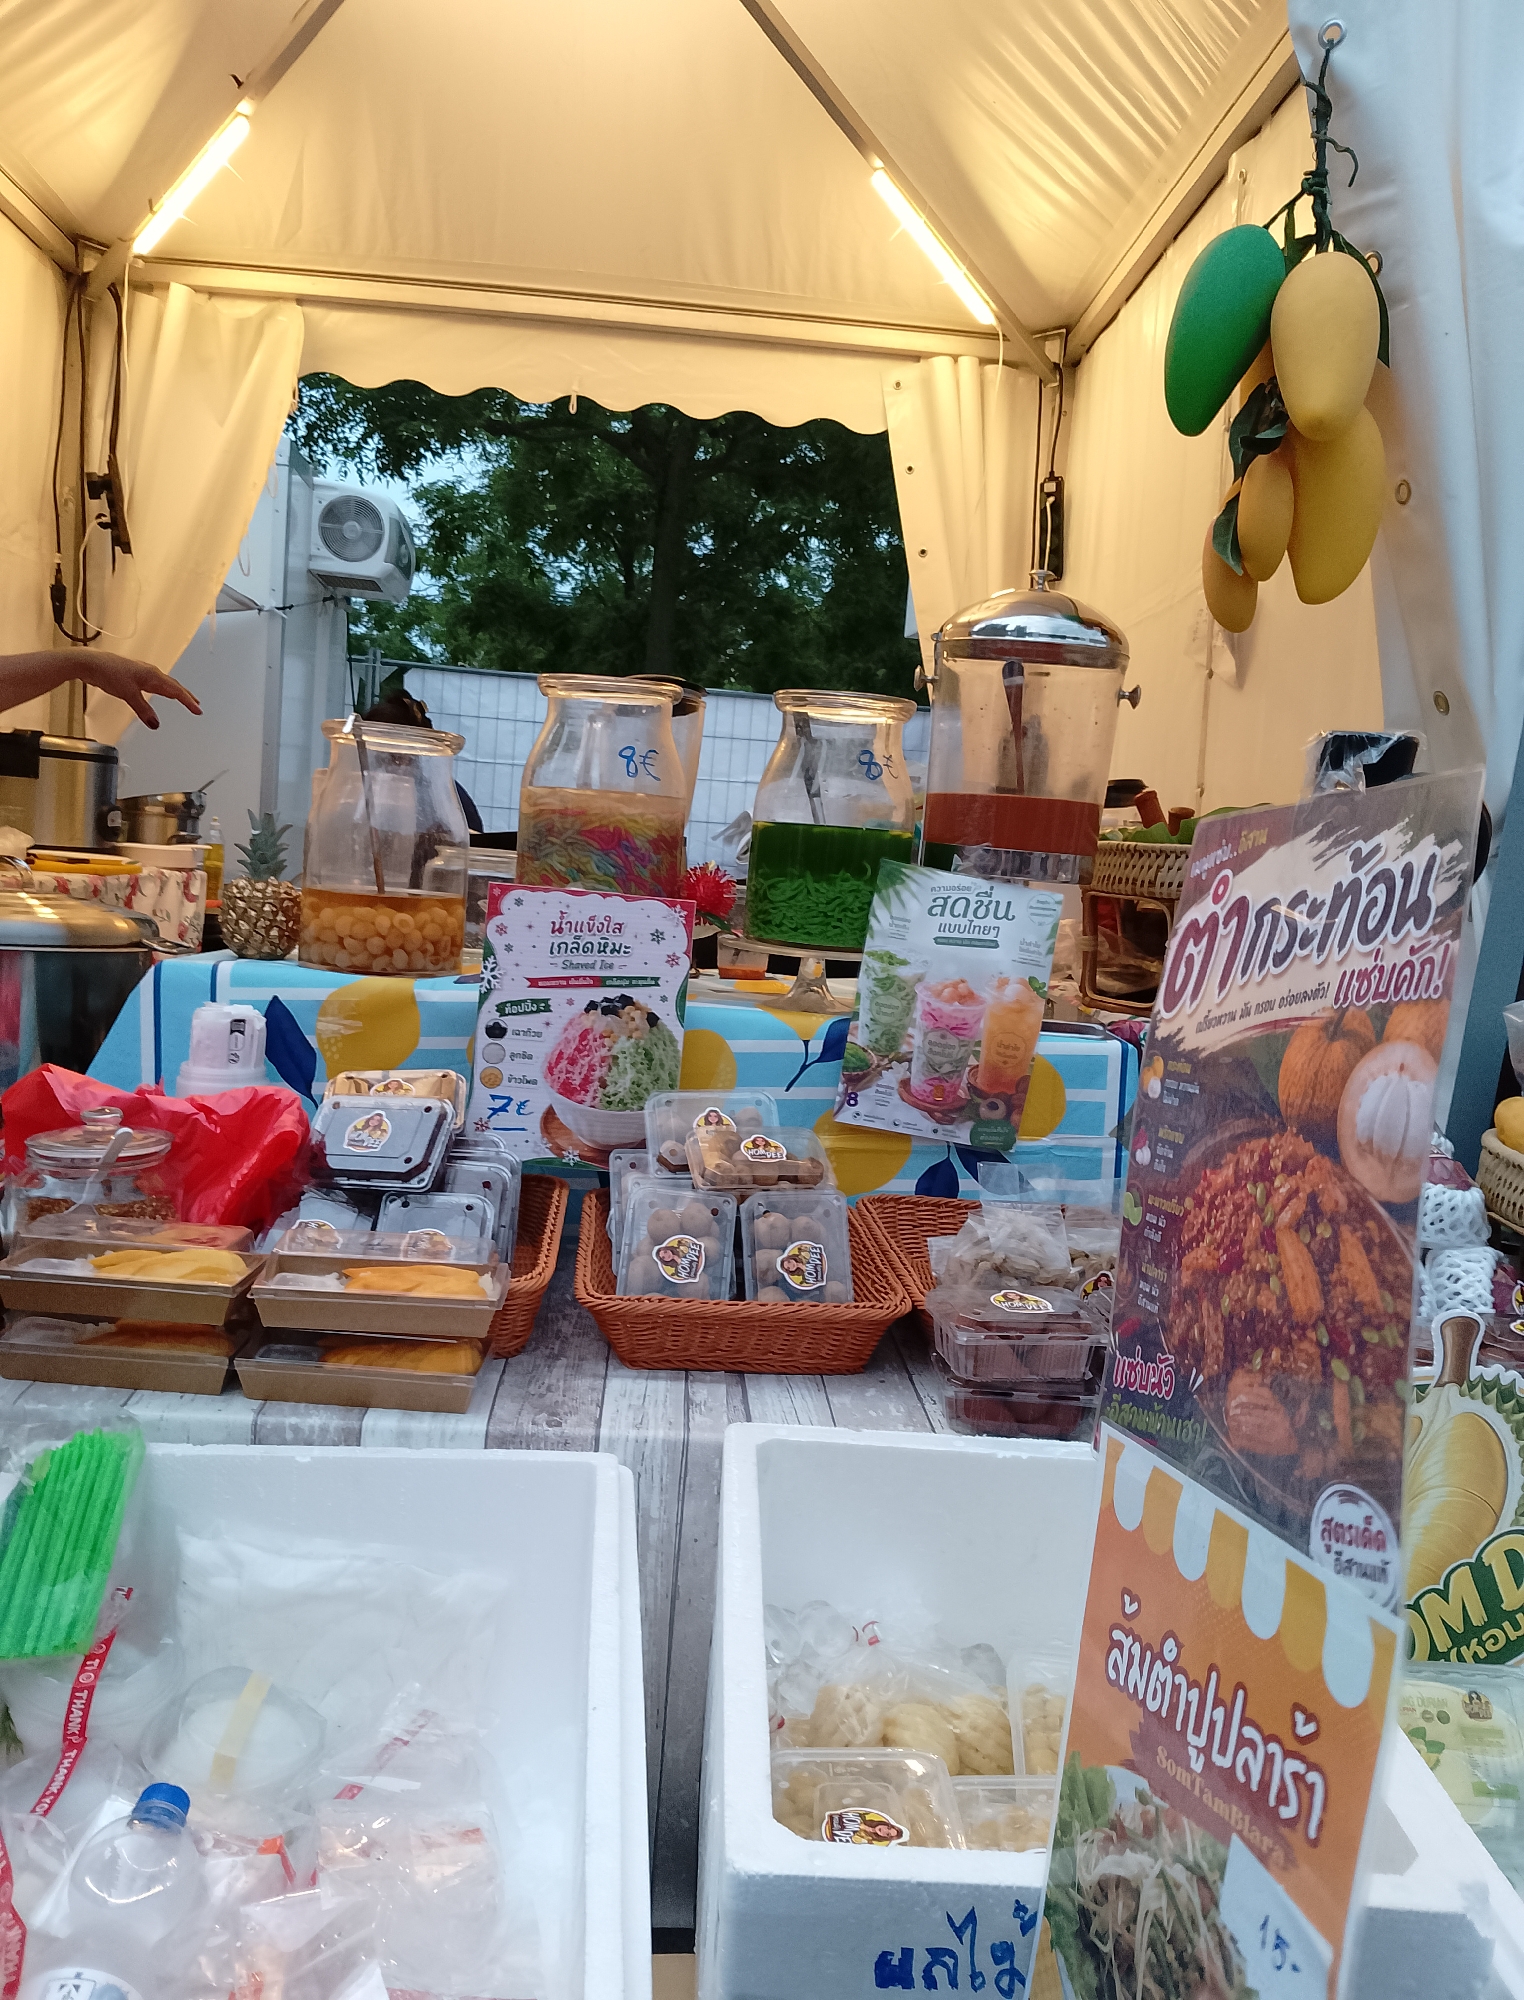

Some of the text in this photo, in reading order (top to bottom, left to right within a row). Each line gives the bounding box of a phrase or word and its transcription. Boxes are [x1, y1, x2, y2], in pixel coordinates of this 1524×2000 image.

[930, 883, 973, 893] ความอร่อย
[927, 885, 1016, 922] สดชื่น
[550, 910, 625, 935] น้ำแข็งใส
[937, 919, 1001, 939] แบบไทยๆ
[1160, 841, 1440, 1017] ตำกระท้อน
[549, 934, 632, 955] เกล็ดหิมะ
[561, 959, 615, 970] Shaved Ice
[1333, 940, 1452, 1008] แซ่บคัก!
[504, 1000, 538, 1015] ท็อปปิ้ง
[487, 1093, 534, 1119] 7€
[846, 1091, 859, 1108] 8
[1113, 1345, 1175, 1400] แซ่บนัว
[1321, 1515, 1387, 1554] สูตรเด็ด
[1333, 1551, 1391, 1585] อีสานแท้
[1106, 1594, 1326, 1840] ส้มตำปูปลาร้า
[34, 1794, 52, 1815] YO
[875, 1899, 1037, 1999] ผลไม้
